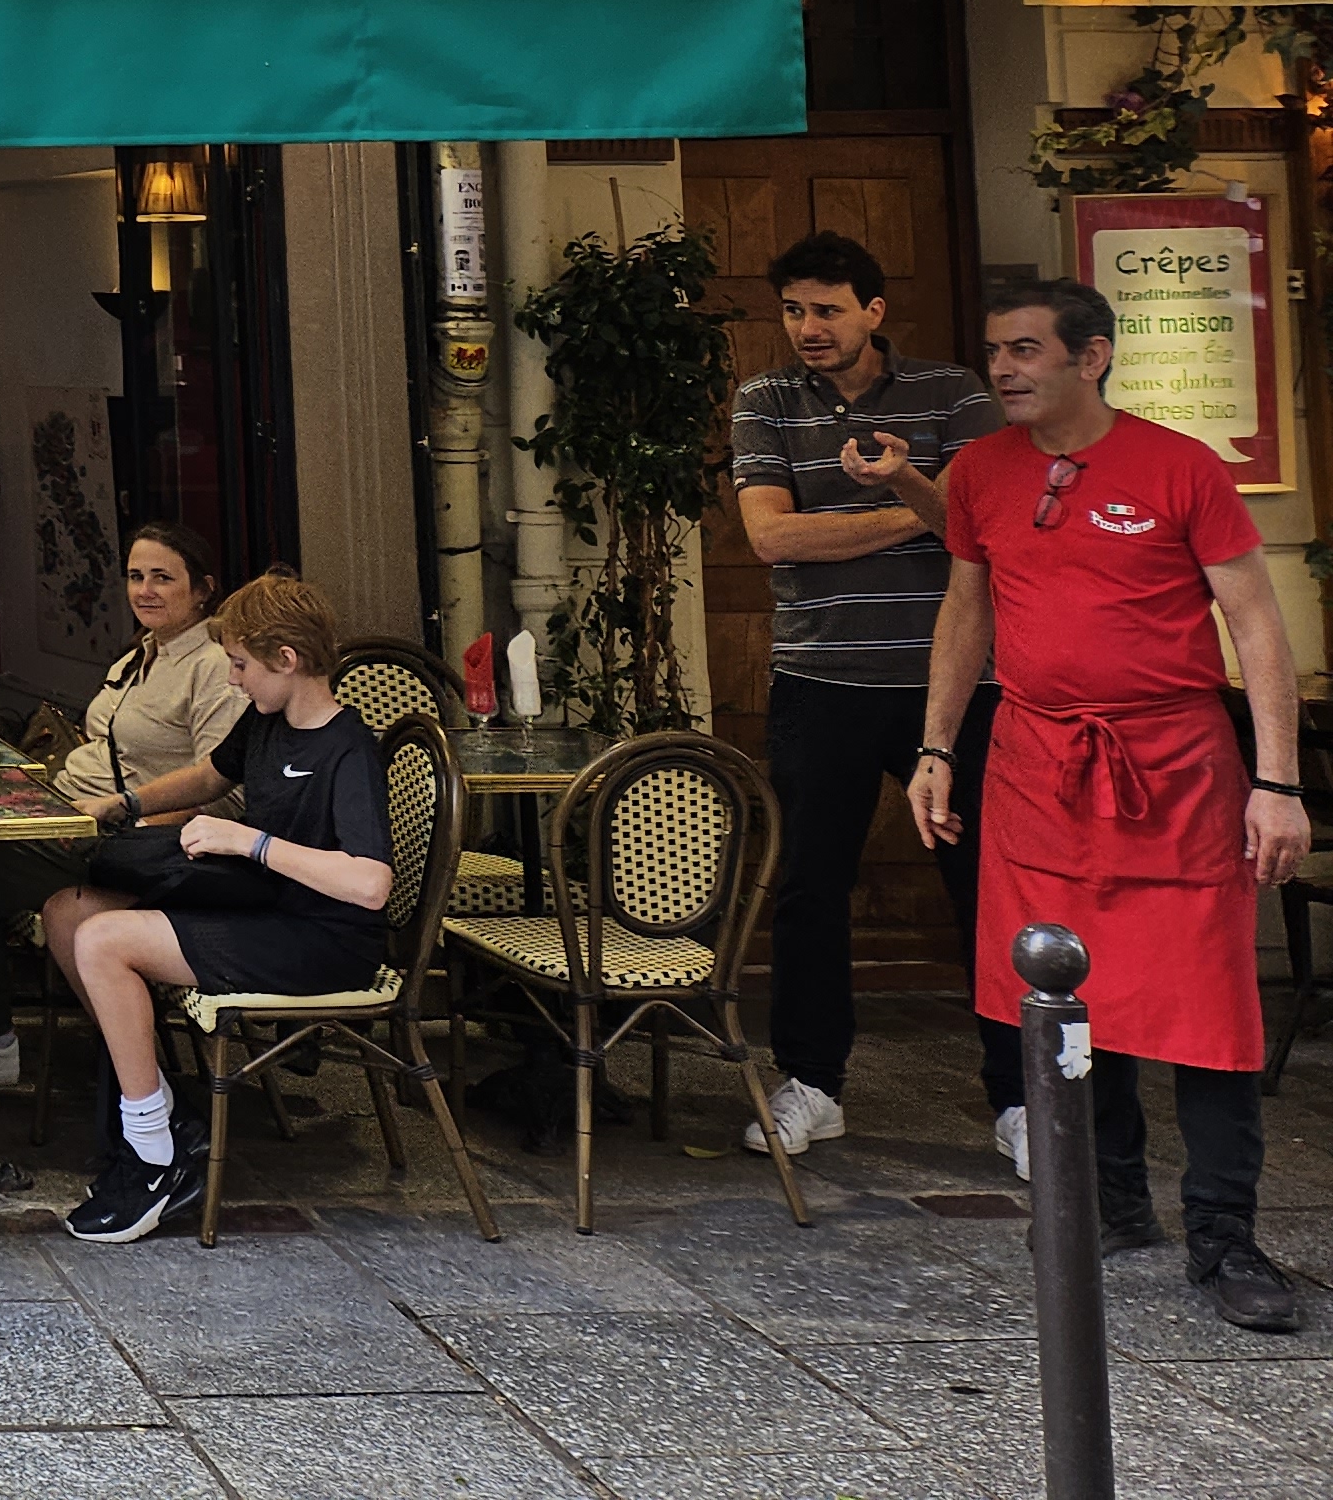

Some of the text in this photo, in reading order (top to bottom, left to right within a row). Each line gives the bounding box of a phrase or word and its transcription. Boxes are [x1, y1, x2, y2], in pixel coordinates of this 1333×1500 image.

[1115, 246, 1230, 283] Crêpes
[1118, 313, 1234, 335] fait maison
[1120, 346, 1198, 366] sarrasin
[1121, 377, 1164, 390] sans
